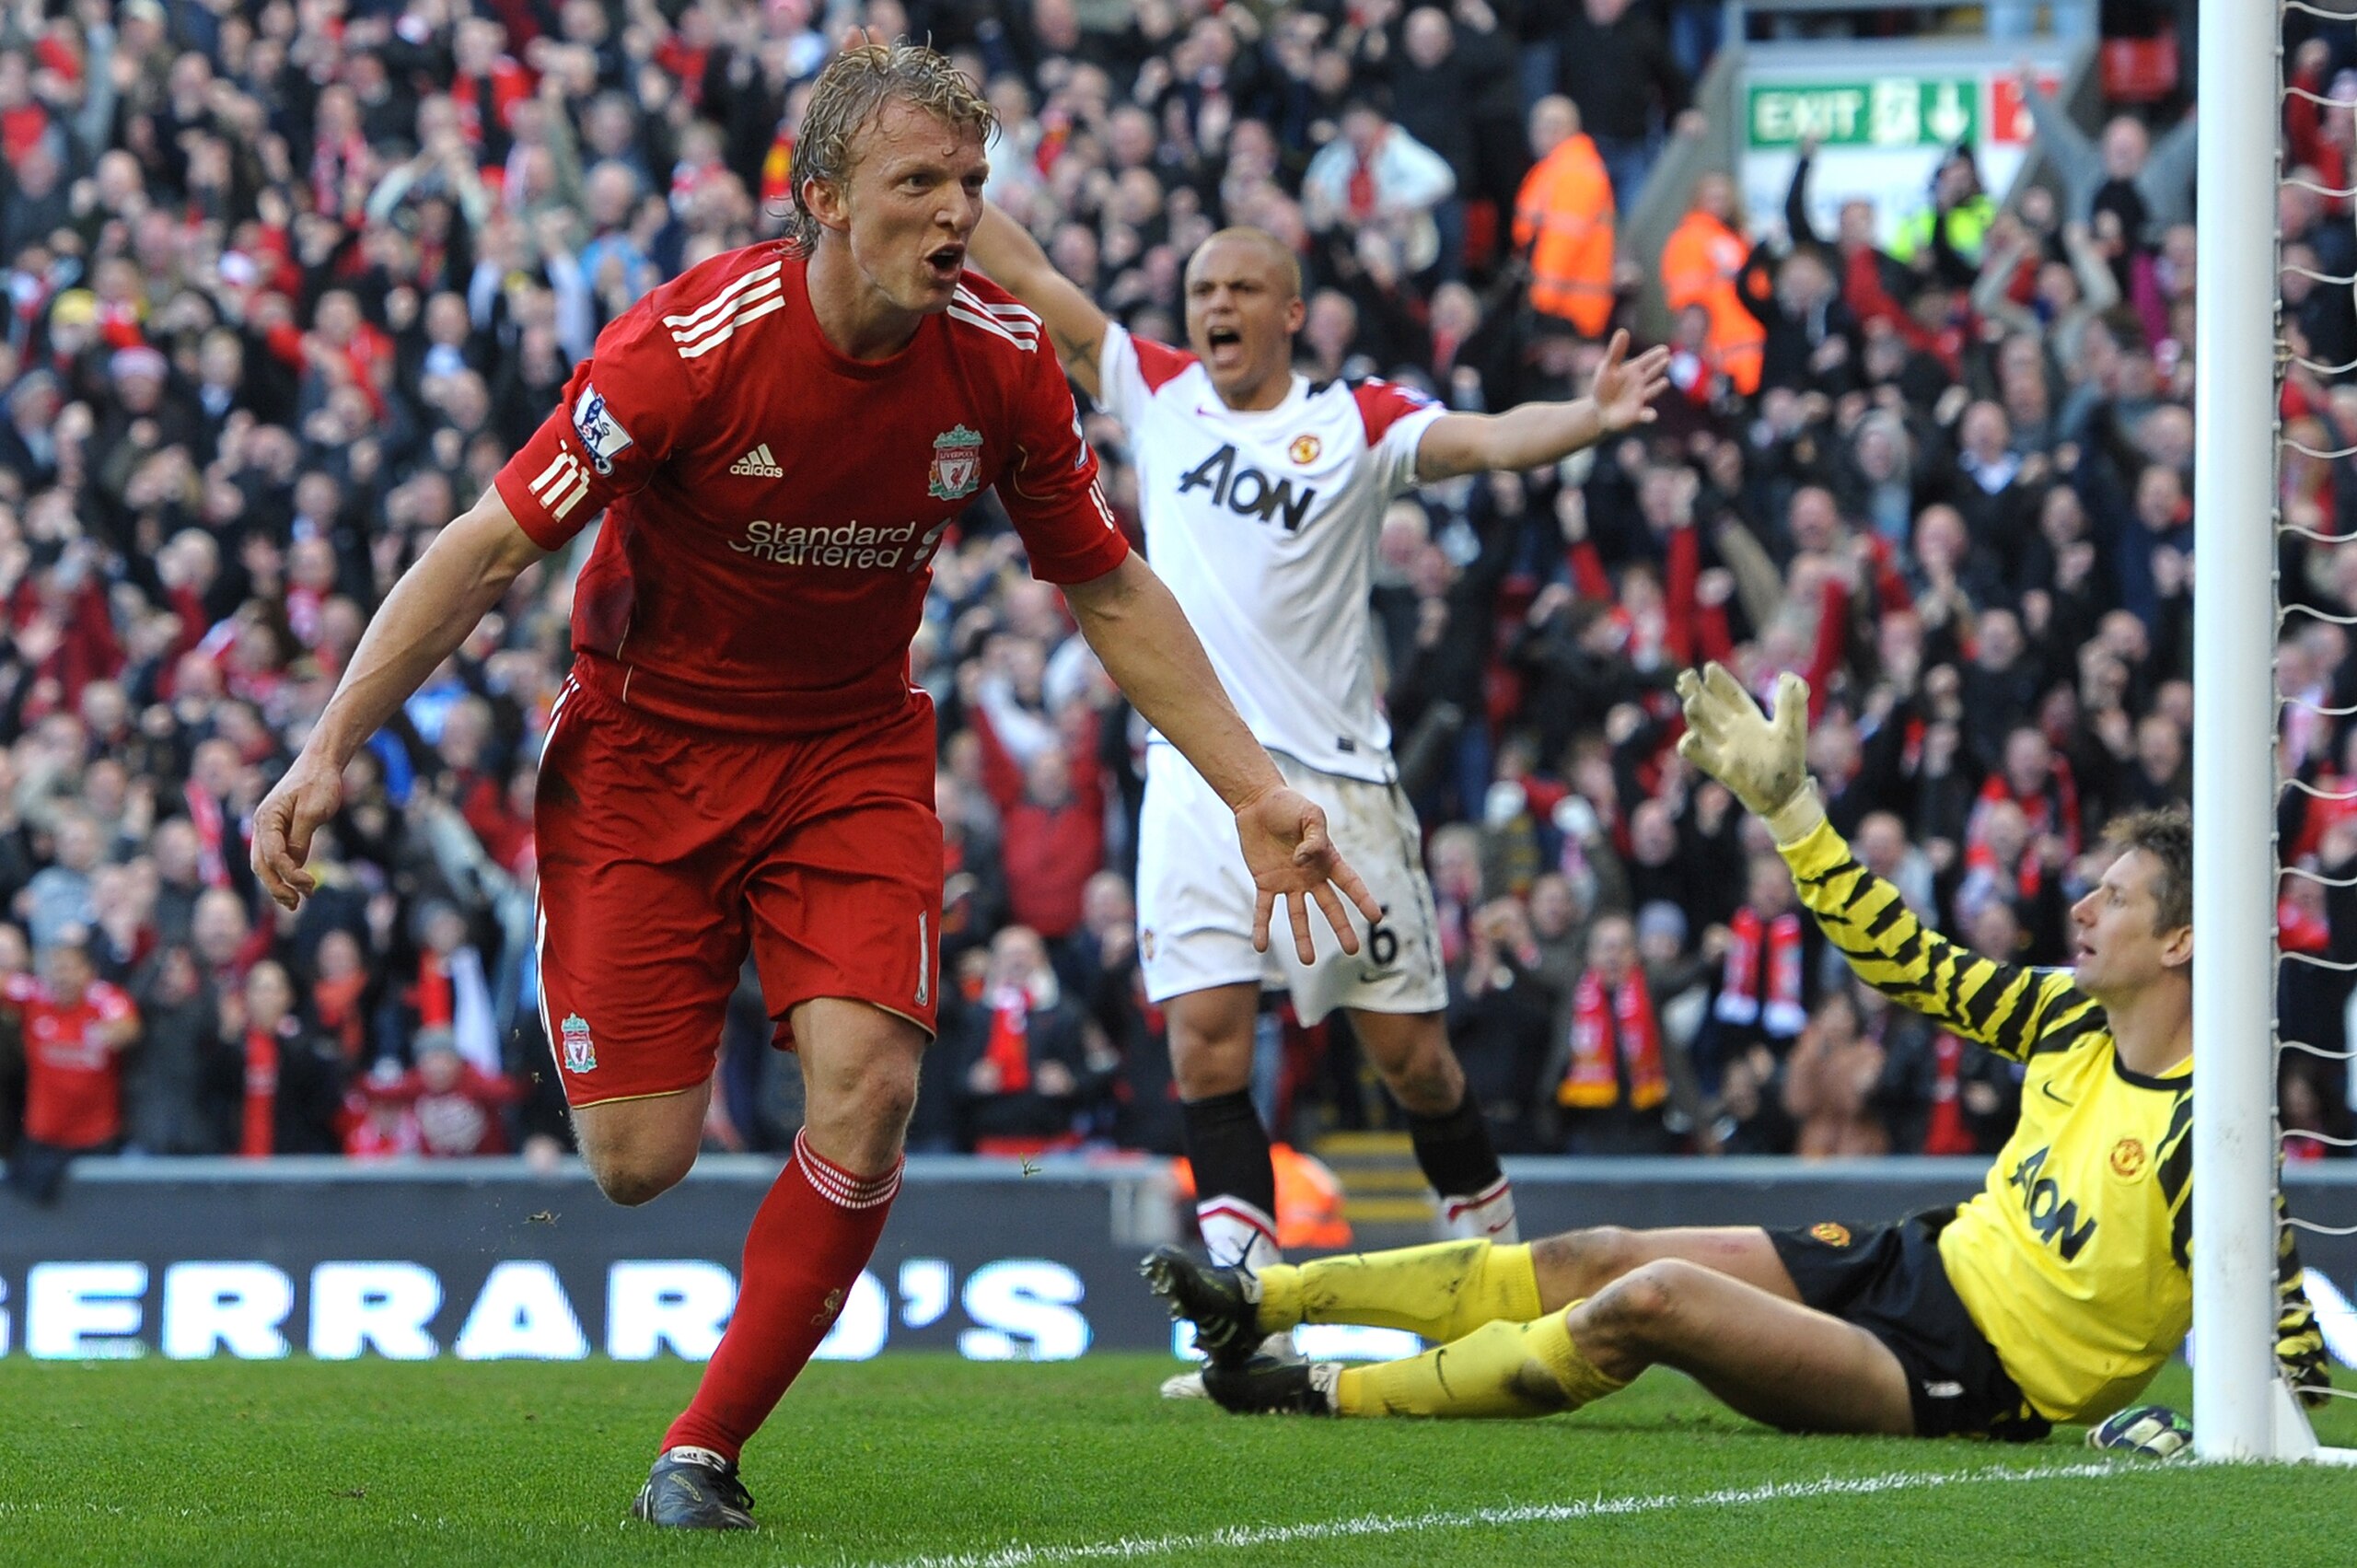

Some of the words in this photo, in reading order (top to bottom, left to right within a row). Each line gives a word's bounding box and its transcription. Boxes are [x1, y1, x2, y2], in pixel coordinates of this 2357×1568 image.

[1754, 90, 1864, 140] EXIT
[730, 463, 784, 478] adidas
[1178, 444, 1317, 531] AON
[746, 520, 916, 546] Standard
[1368, 904, 1398, 966] 6
[2009, 1145, 2098, 1262] AON
[0, 1259, 1094, 1361] ERRAR'S
